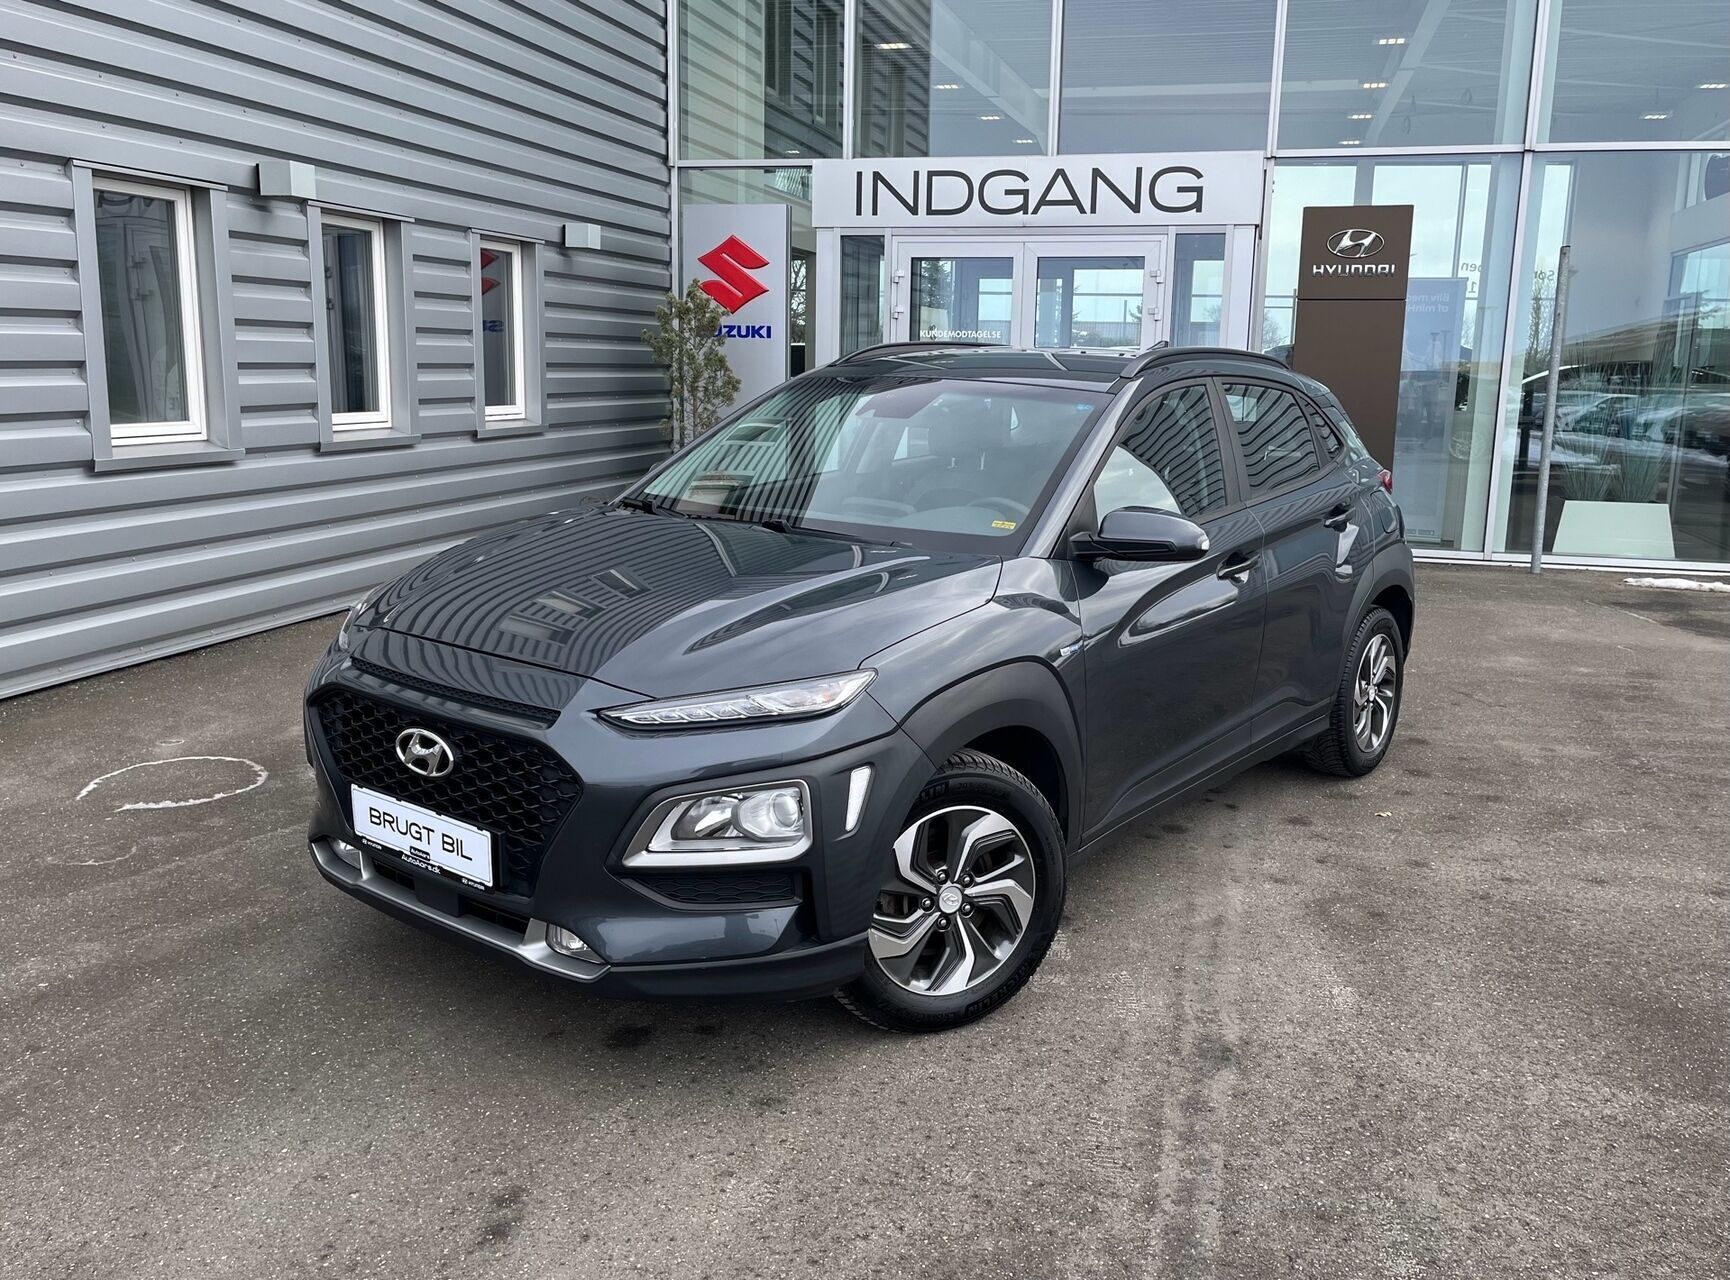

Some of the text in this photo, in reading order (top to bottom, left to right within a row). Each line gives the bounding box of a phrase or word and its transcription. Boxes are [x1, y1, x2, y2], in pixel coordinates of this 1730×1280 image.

[855, 166, 1204, 216] INDGANG
[1312, 264, 1396, 277] HYUNDAI
[713, 324, 772, 339] UZUKI
[919, 329, 1001, 339] KUNDEMODTAGELSE
[369, 806, 473, 862] BRUGT BIL
